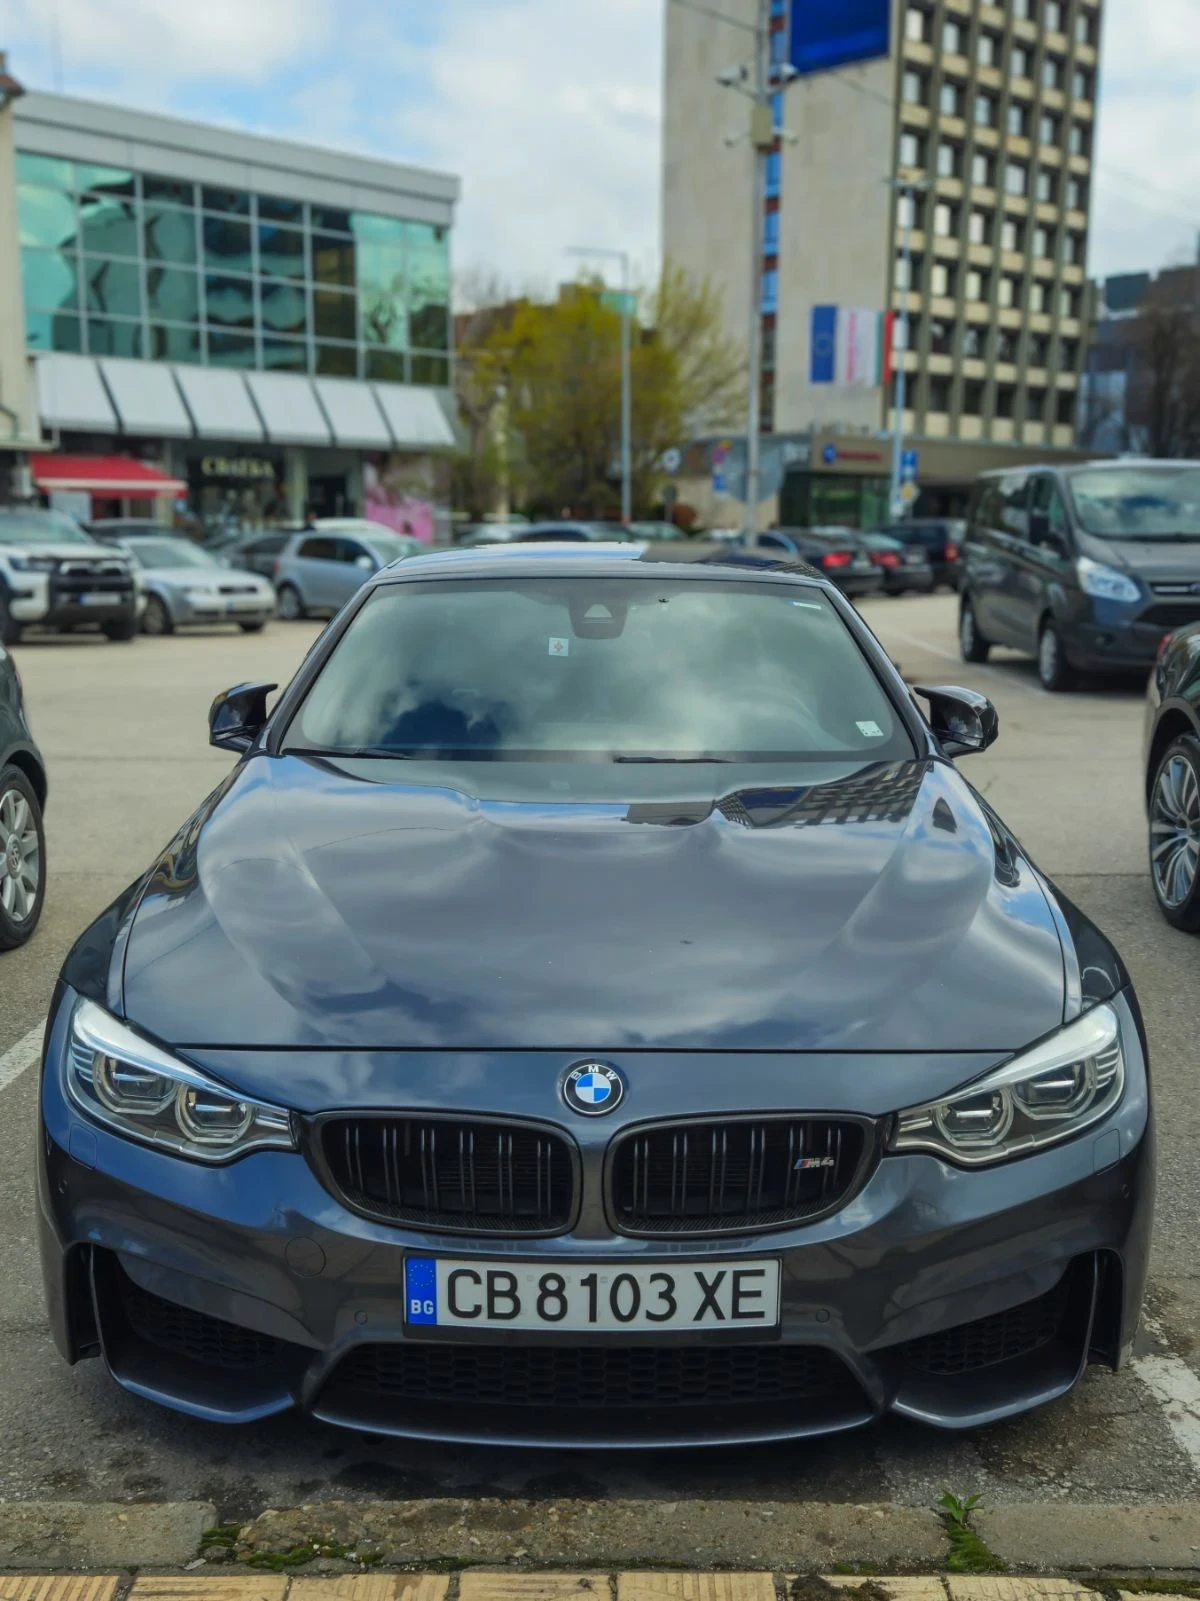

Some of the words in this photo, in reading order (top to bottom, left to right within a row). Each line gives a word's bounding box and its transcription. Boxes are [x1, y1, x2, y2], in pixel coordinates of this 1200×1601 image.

[570, 1065, 618, 1081] BMW
[807, 1156, 835, 1168] M4
[447, 1268, 521, 1320] CB
[536, 1271, 677, 1323] 8103
[692, 1268, 766, 1321] XE
[410, 1299, 434, 1315] BG
